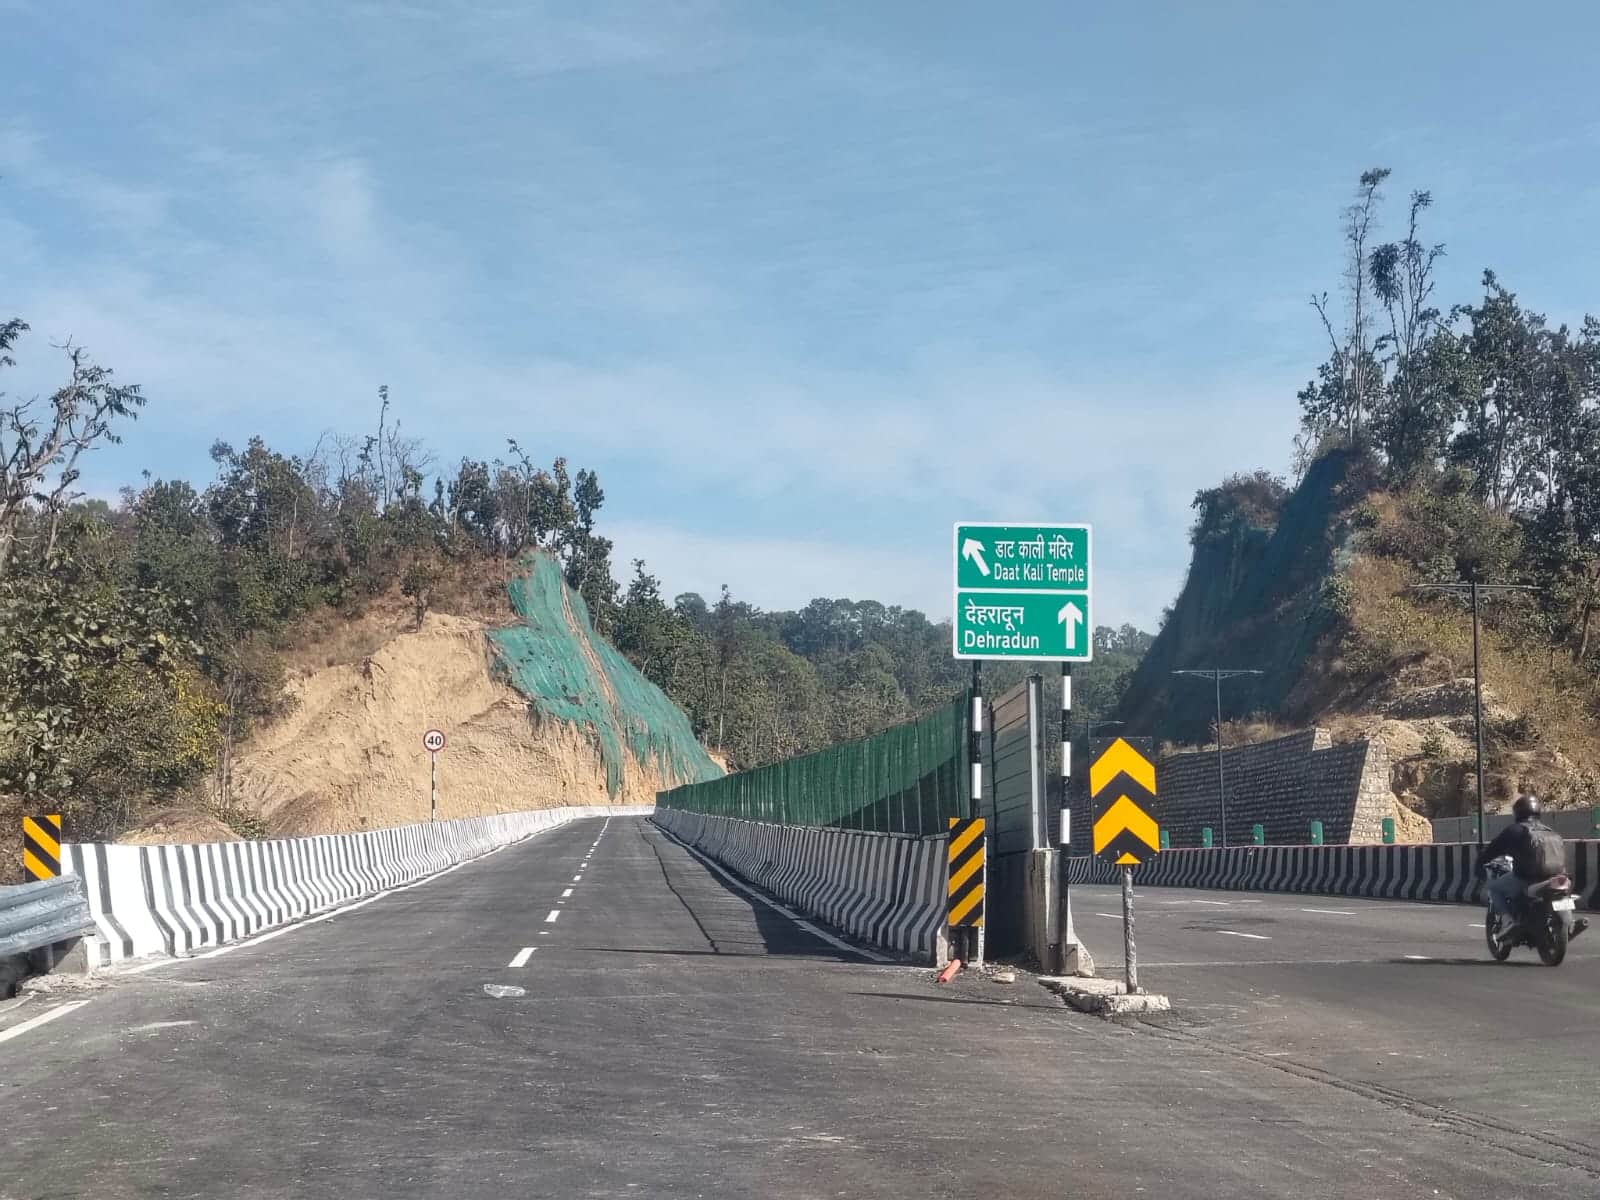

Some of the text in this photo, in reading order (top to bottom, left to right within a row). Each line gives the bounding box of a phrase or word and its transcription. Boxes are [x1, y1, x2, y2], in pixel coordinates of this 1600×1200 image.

[994, 533, 1074, 560] डाट काली मंदिर
[994, 563, 1085, 585] Daat Kali Temple
[964, 598, 1025, 631] देहरादून
[964, 630, 1040, 649] Dehradun
[427, 735, 442, 746] 40
